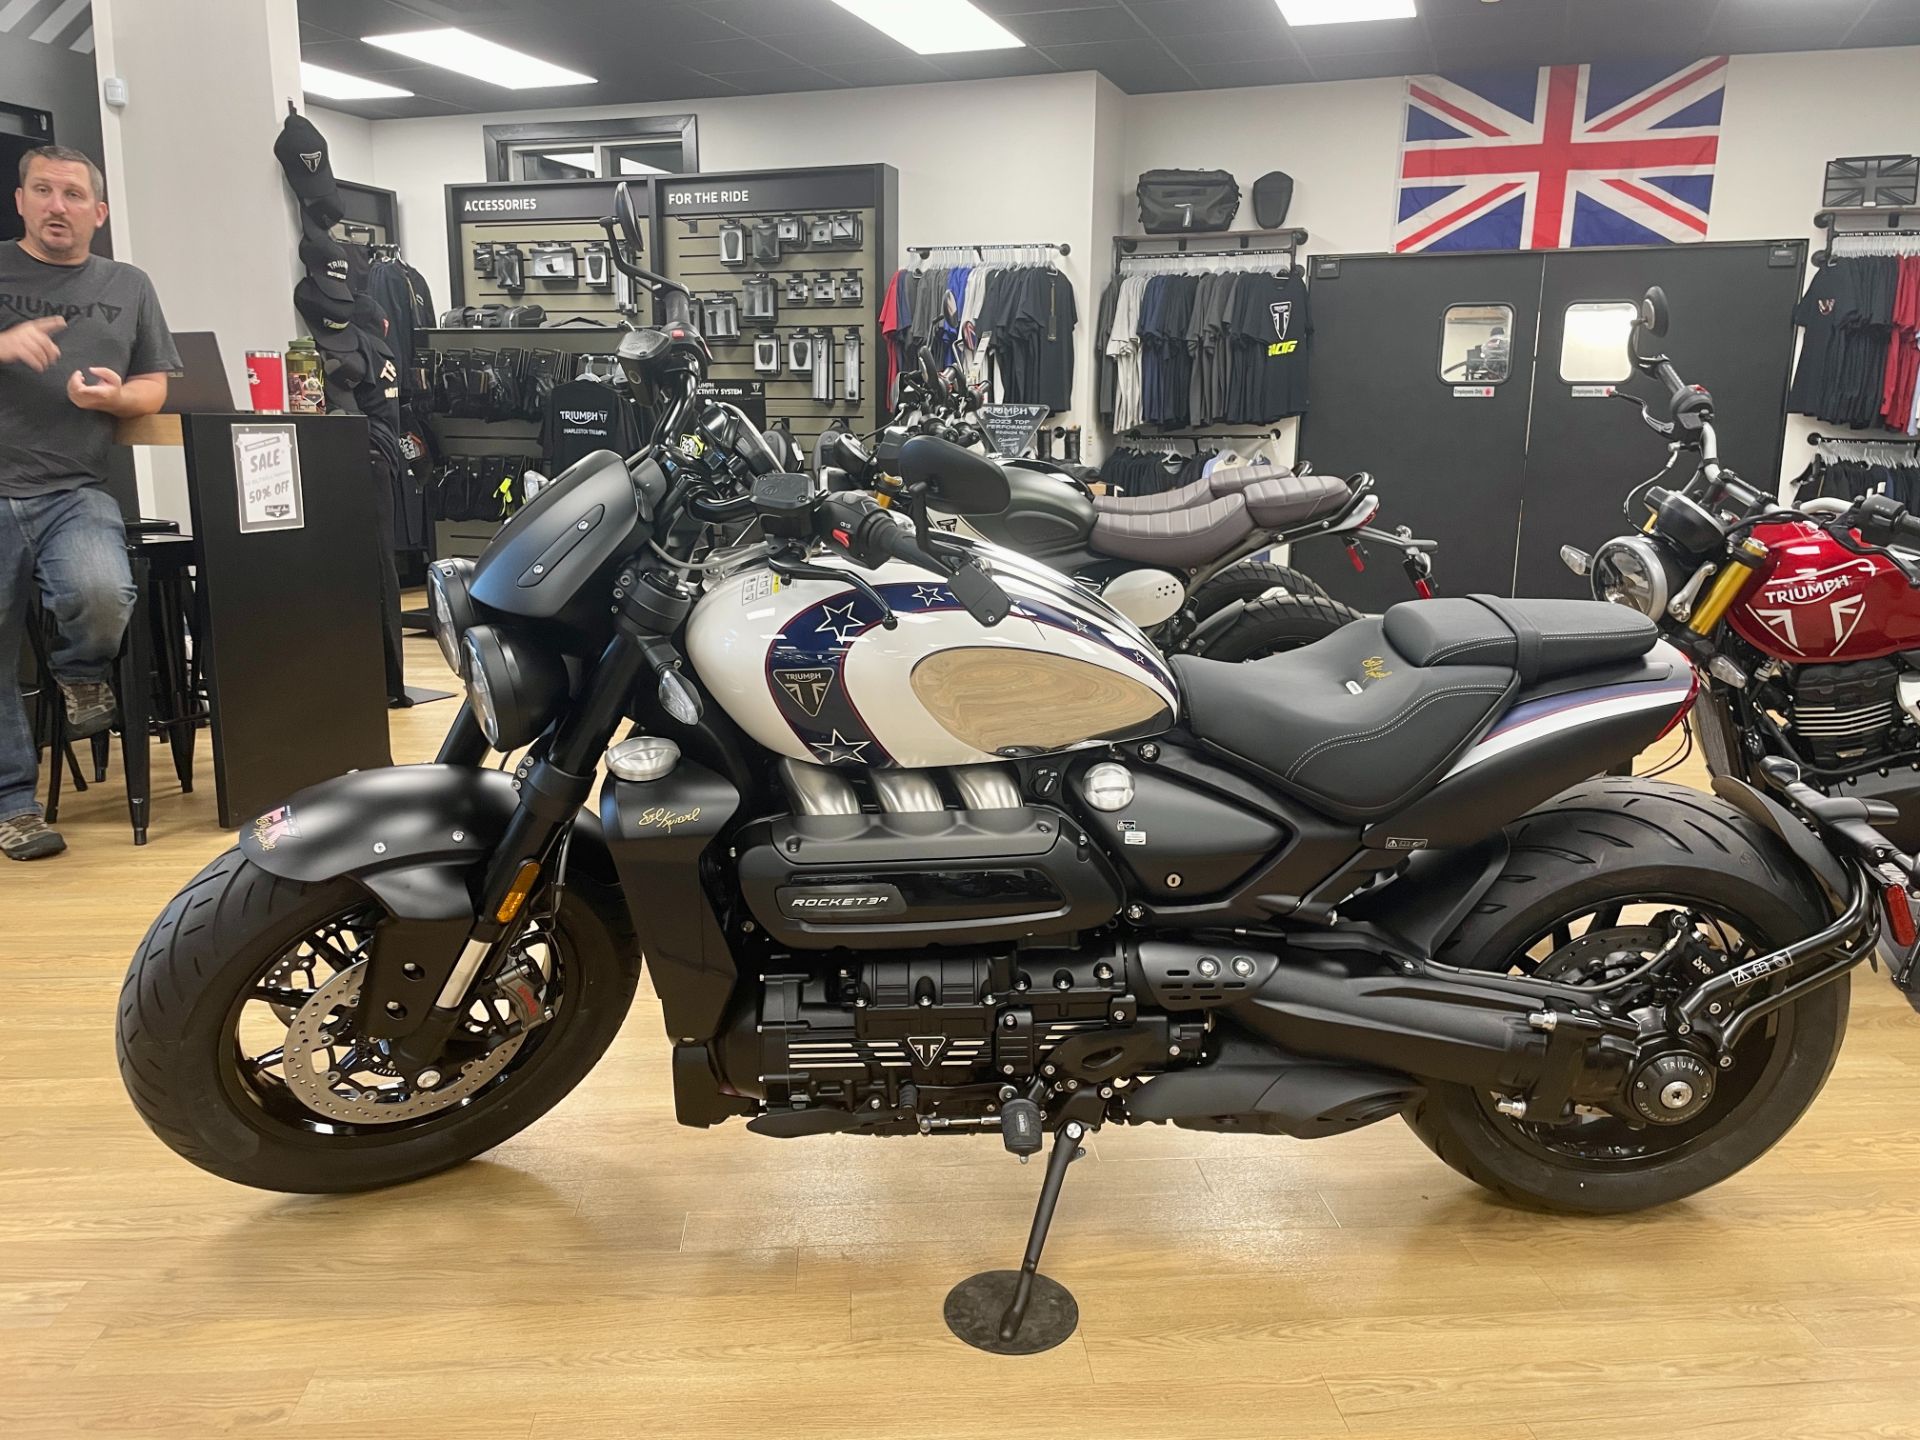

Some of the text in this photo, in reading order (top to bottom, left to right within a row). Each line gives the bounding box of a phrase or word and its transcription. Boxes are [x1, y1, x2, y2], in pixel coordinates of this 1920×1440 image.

[464, 198, 537, 212] ACCESSORIES
[667, 189, 749, 205] FOR THE RIDE
[720, 388, 743, 396] SYSTEM
[559, 410, 598, 424] TRIUMPH
[250, 448, 281, 473] SALE
[248, 480, 290, 504] 50% OFF
[1764, 574, 1851, 605] TRIUMPH
[784, 672, 821, 683] TRIUMPH
[1663, 1060, 1705, 1077] TRIUMPH
